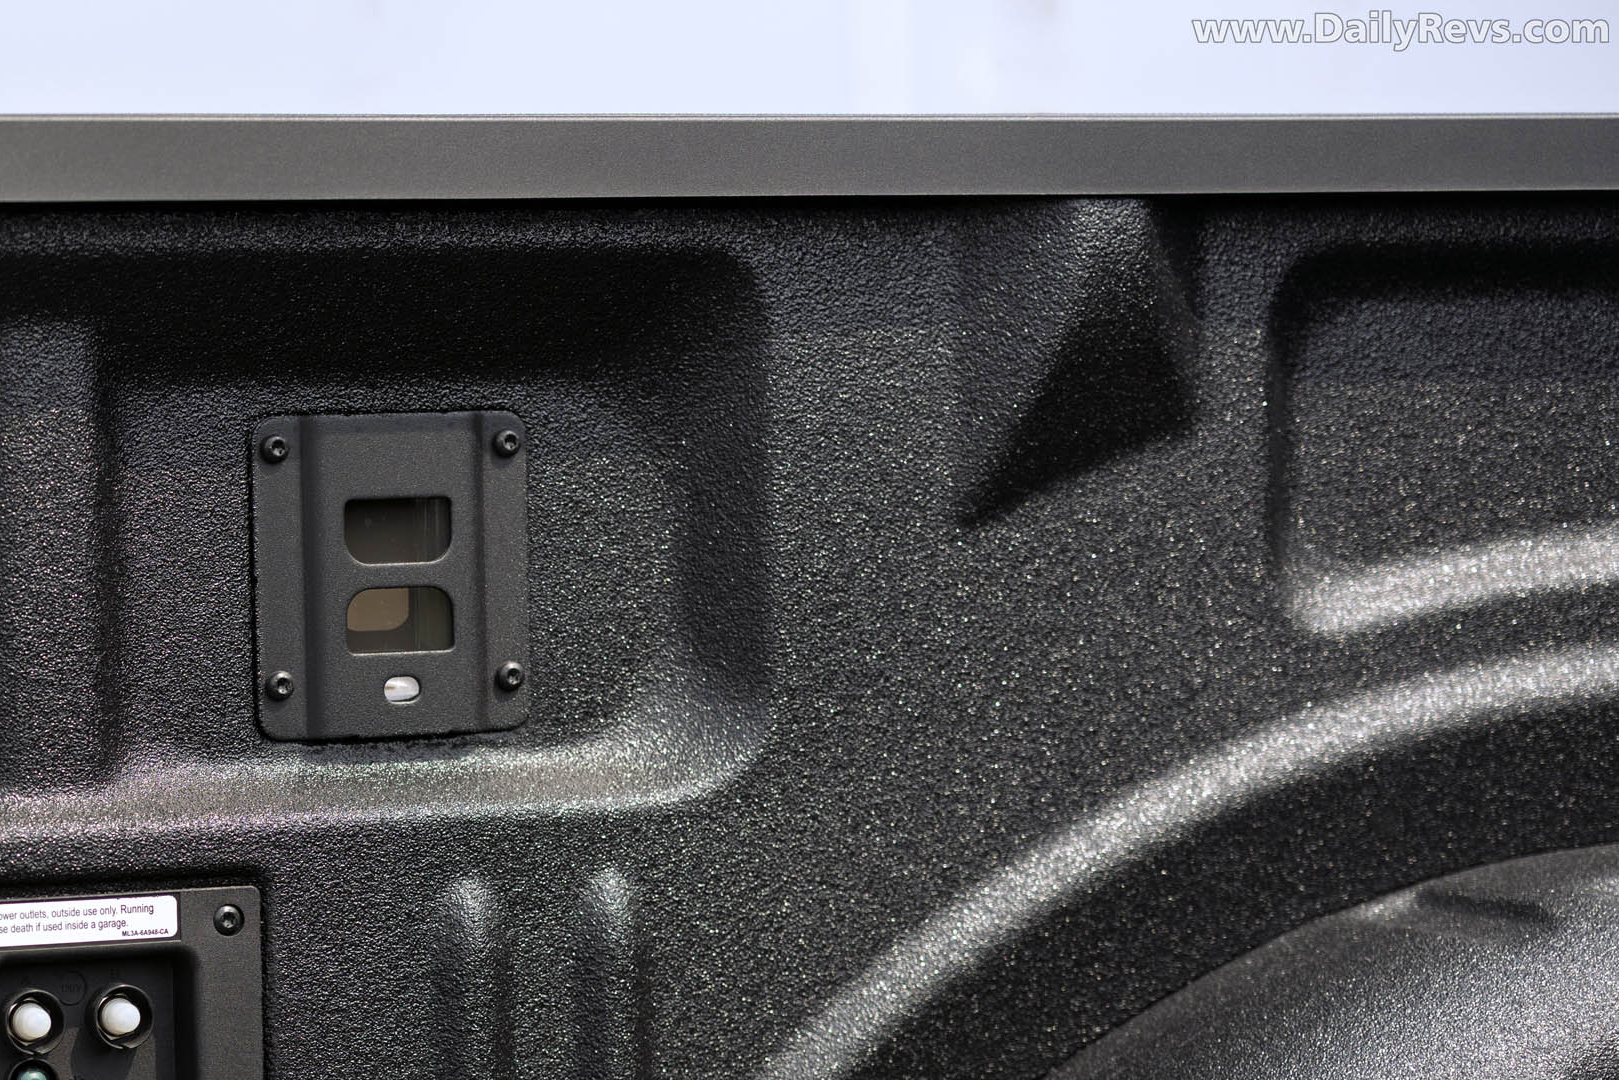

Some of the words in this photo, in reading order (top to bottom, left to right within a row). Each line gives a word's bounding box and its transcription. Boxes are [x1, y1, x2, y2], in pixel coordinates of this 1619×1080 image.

[20, 909, 49, 919] outlets,
[51, 908, 80, 918] outside
[83, 907, 97, 916] use
[100, 905, 118, 917] only.
[121, 904, 154, 915] Running
[11, 923, 33, 933] death
[36, 922, 42, 931] if
[43, 921, 62, 931] used
[65, 920, 89, 930] inside
[98, 919, 129, 930] garage.
